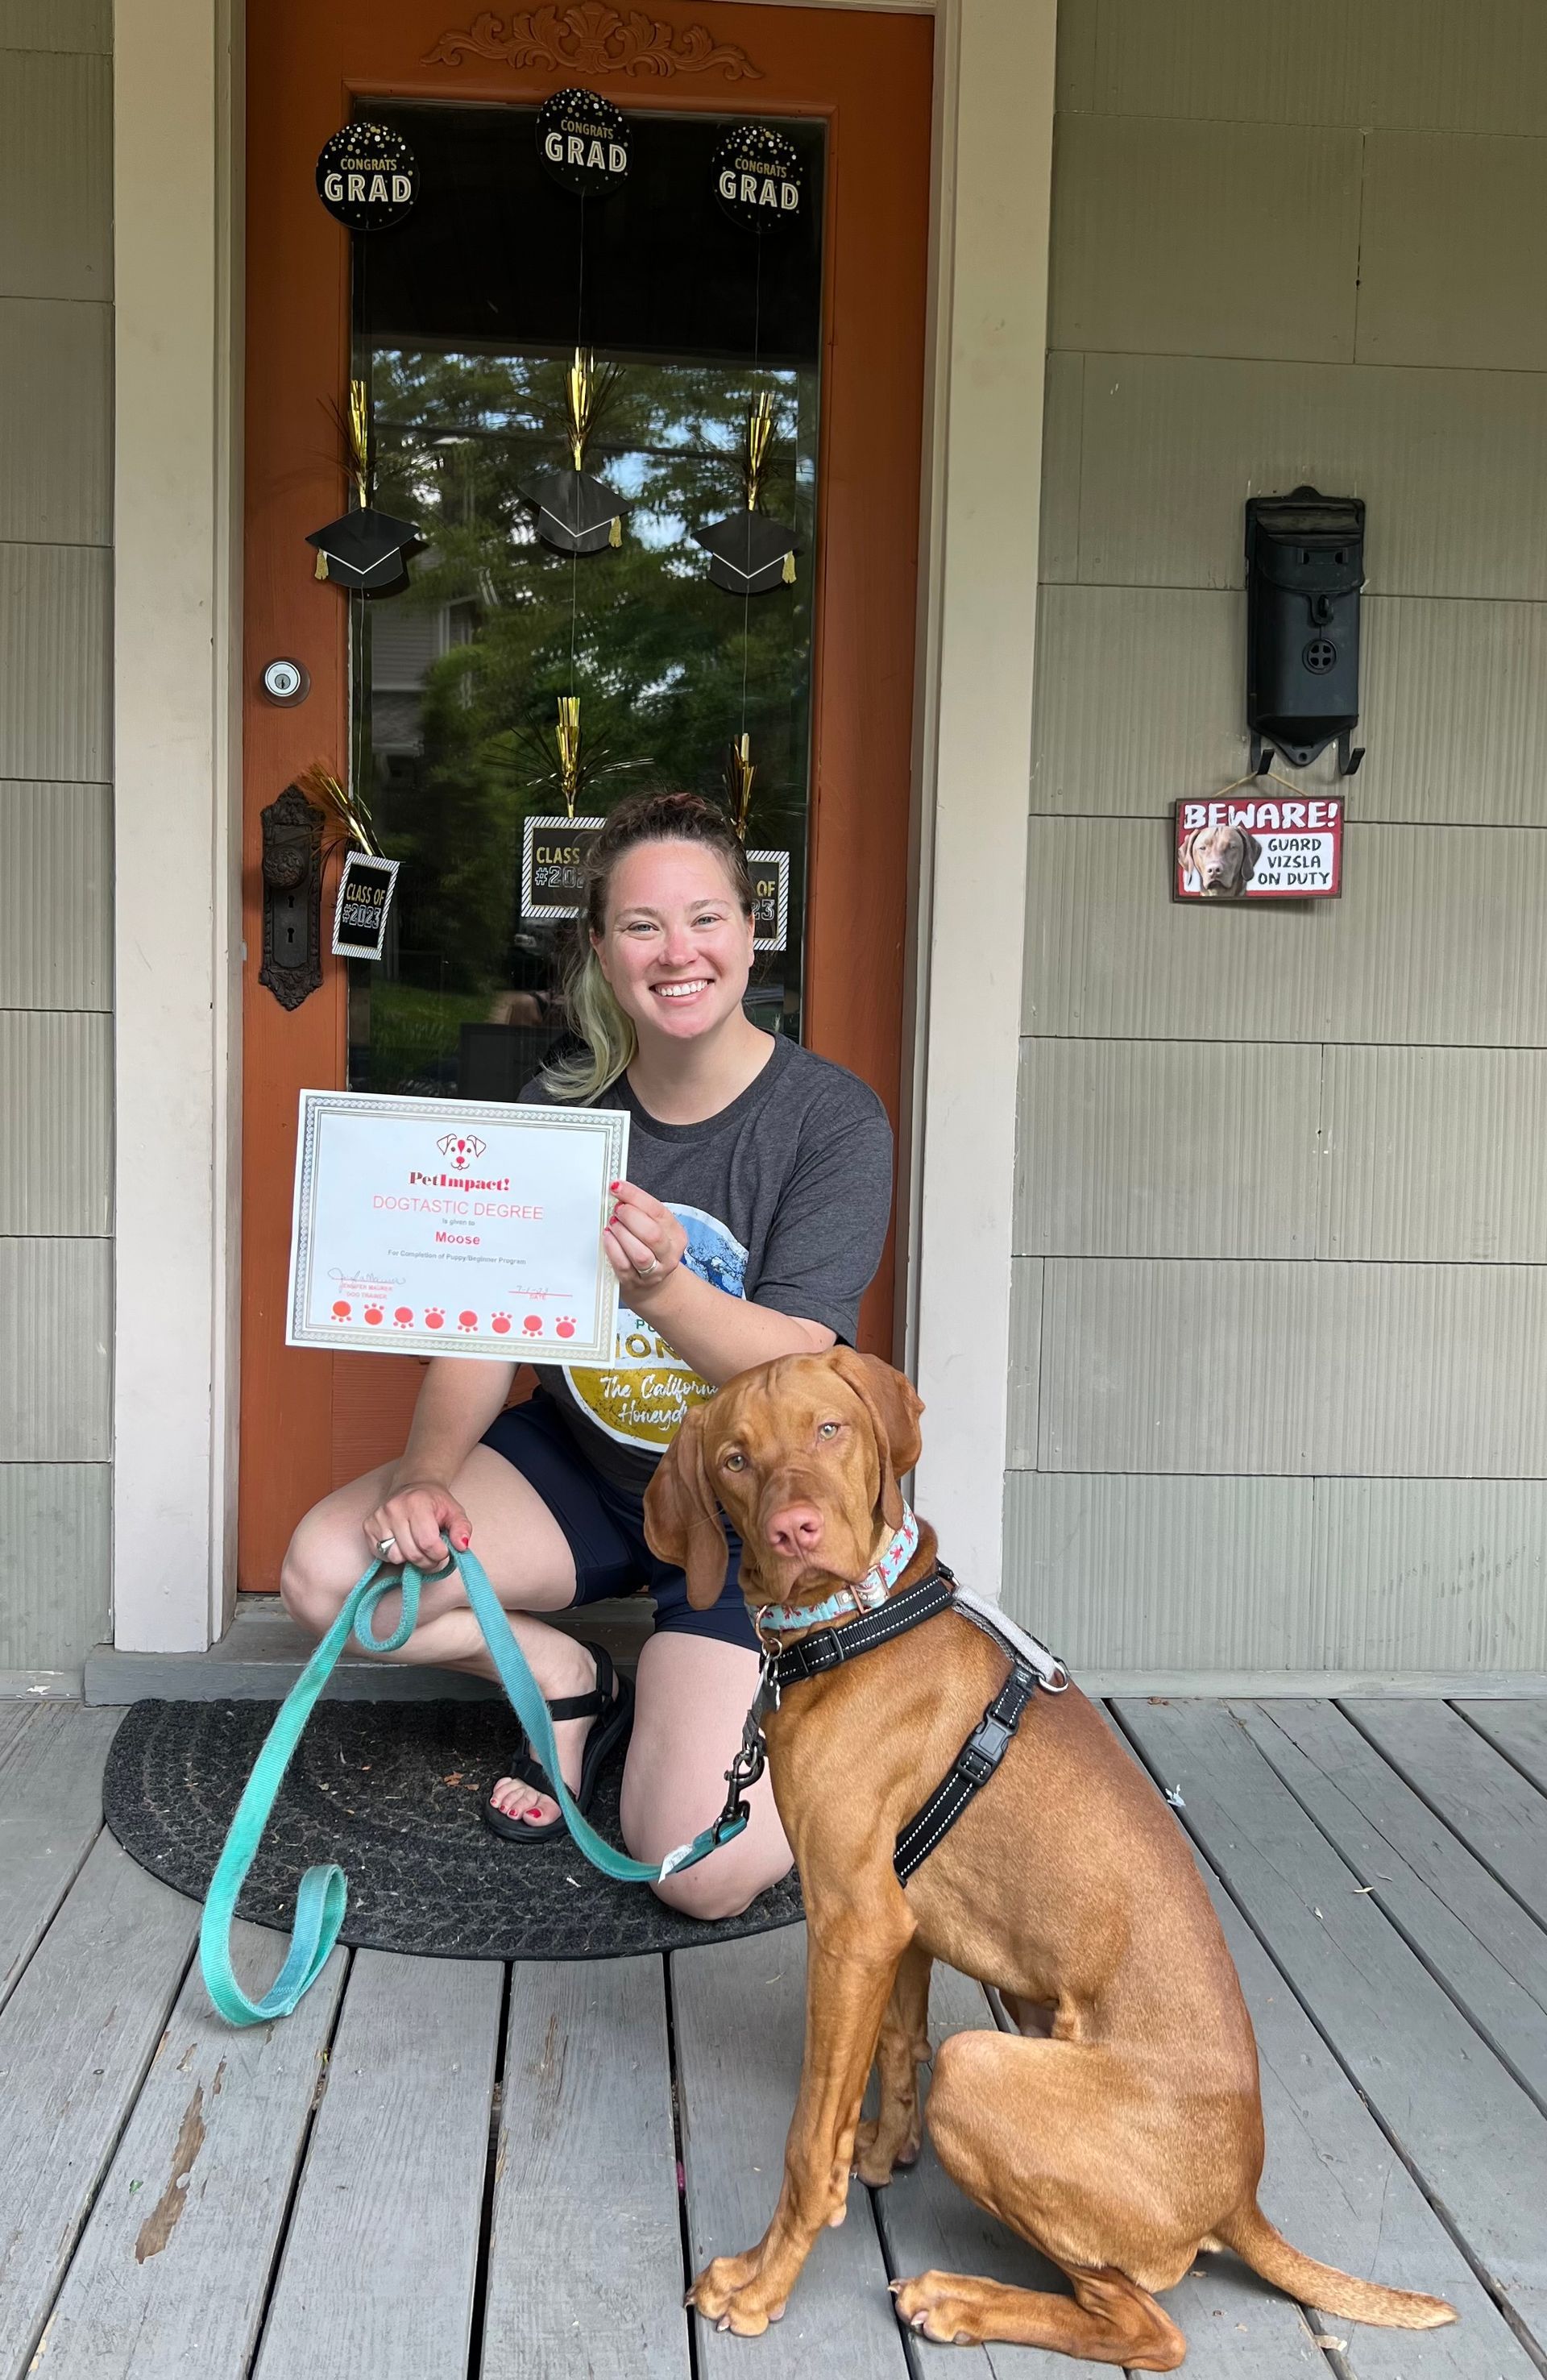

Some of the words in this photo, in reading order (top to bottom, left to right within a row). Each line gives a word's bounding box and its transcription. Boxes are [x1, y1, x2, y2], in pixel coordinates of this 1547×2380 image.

[560, 119, 614, 140] CONGRATS
[545, 132, 628, 172] GRAD
[340, 157, 397, 172] CONGRATS
[734, 157, 787, 179] CONGRATS
[324, 173, 412, 202] GRAD
[719, 171, 799, 211] GRAD
[1184, 802, 1338, 830] BEWARE!
[1268, 838, 1321, 852] GUARD
[536, 847, 580, 865] CLASS
[1267, 856, 1321, 869] VIZSLA
[757, 880, 775, 897] OF
[1258, 873, 1281, 885] ON
[1287, 872, 1329, 885] DUTY
[346, 882, 372, 904] CLASS
[374, 888, 386, 906] OF
[342, 903, 382, 930] #2023
[409, 1171, 510, 1192] PetImpact!
[373, 1196, 468, 1215] DOGTASTIC
[474, 1202, 544, 1221] DEGREE
[449, 1219, 468, 1227] given
[435, 1231, 480, 1246] Moose
[400, 1250, 437, 1259] Completion
[600, 1376, 632, 1399] The
